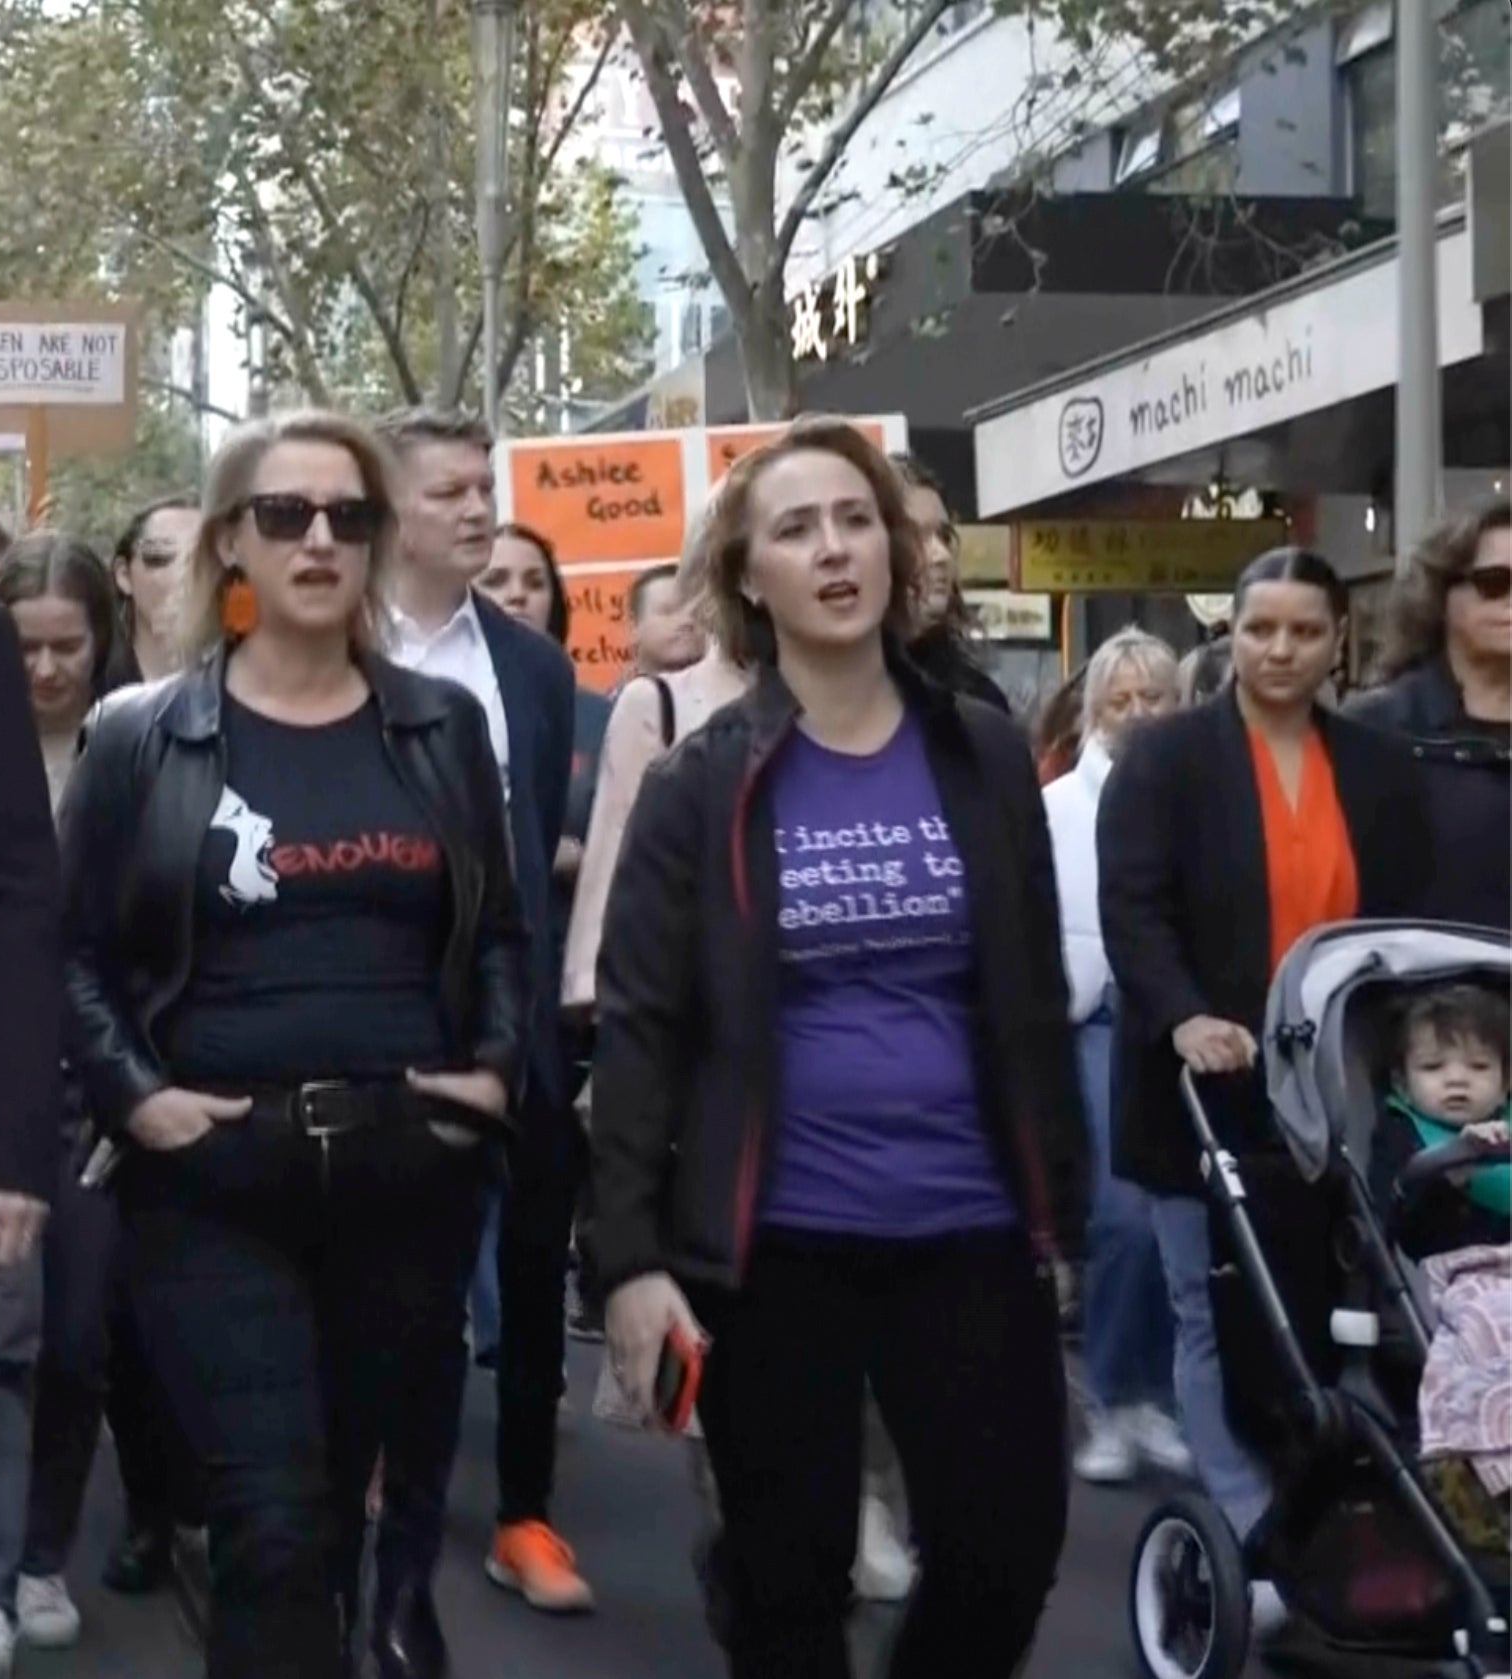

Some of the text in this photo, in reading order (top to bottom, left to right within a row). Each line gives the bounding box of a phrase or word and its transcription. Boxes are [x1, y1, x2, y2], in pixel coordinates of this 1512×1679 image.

[39, 333, 72, 354] ARE
[81, 334, 118, 355] NOT
[1128, 324, 1313, 436] machi machi
[536, 455, 643, 489] Ashlee
[586, 488, 663, 522] Good
[794, 821, 911, 852] incite
